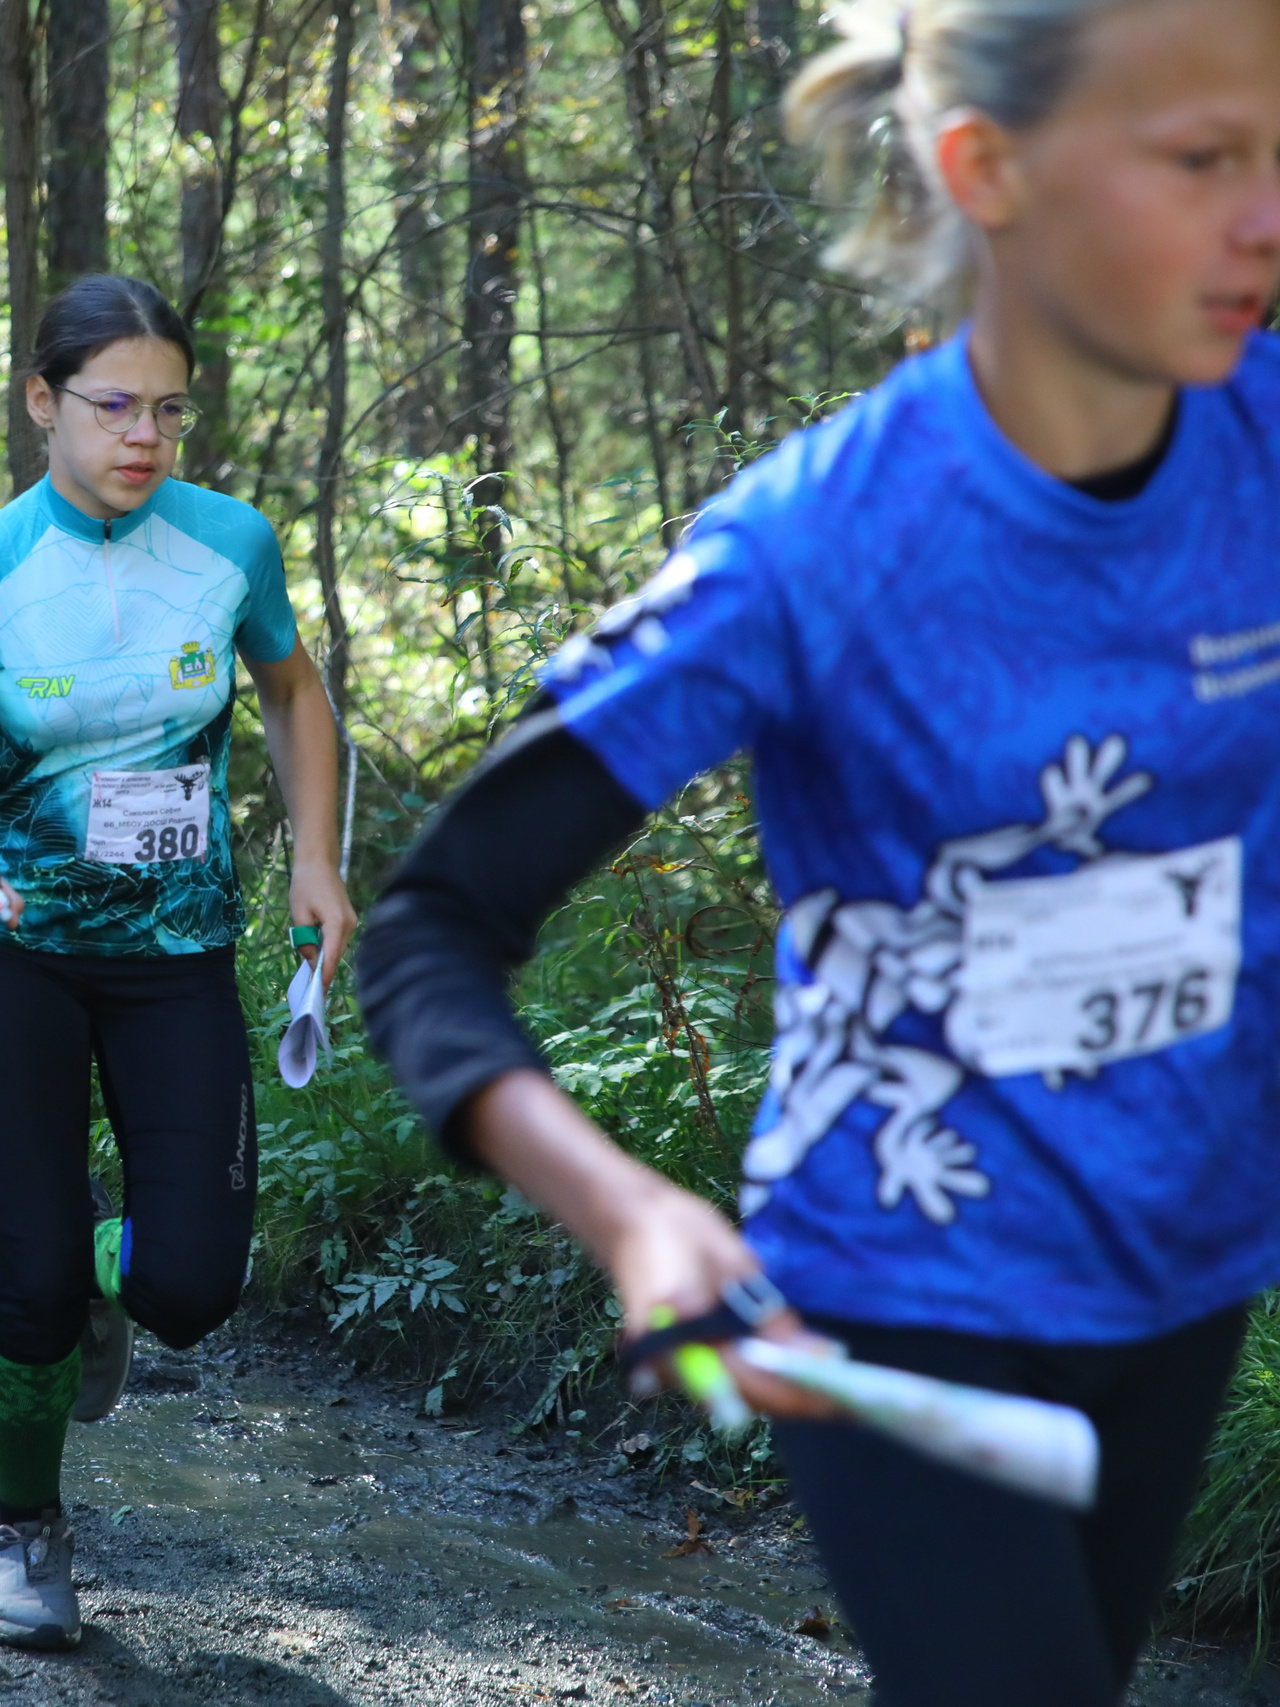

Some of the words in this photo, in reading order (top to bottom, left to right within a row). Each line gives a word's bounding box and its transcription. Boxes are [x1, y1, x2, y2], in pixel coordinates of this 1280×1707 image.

[92, 798, 113, 809] Ж14
[123, 808, 159, 817] Соколова
[159, 806, 182, 815] София
[134, 823, 199, 862] 380
[1077, 967, 1210, 1051] 376
[236, 1083, 248, 1163] NORD
